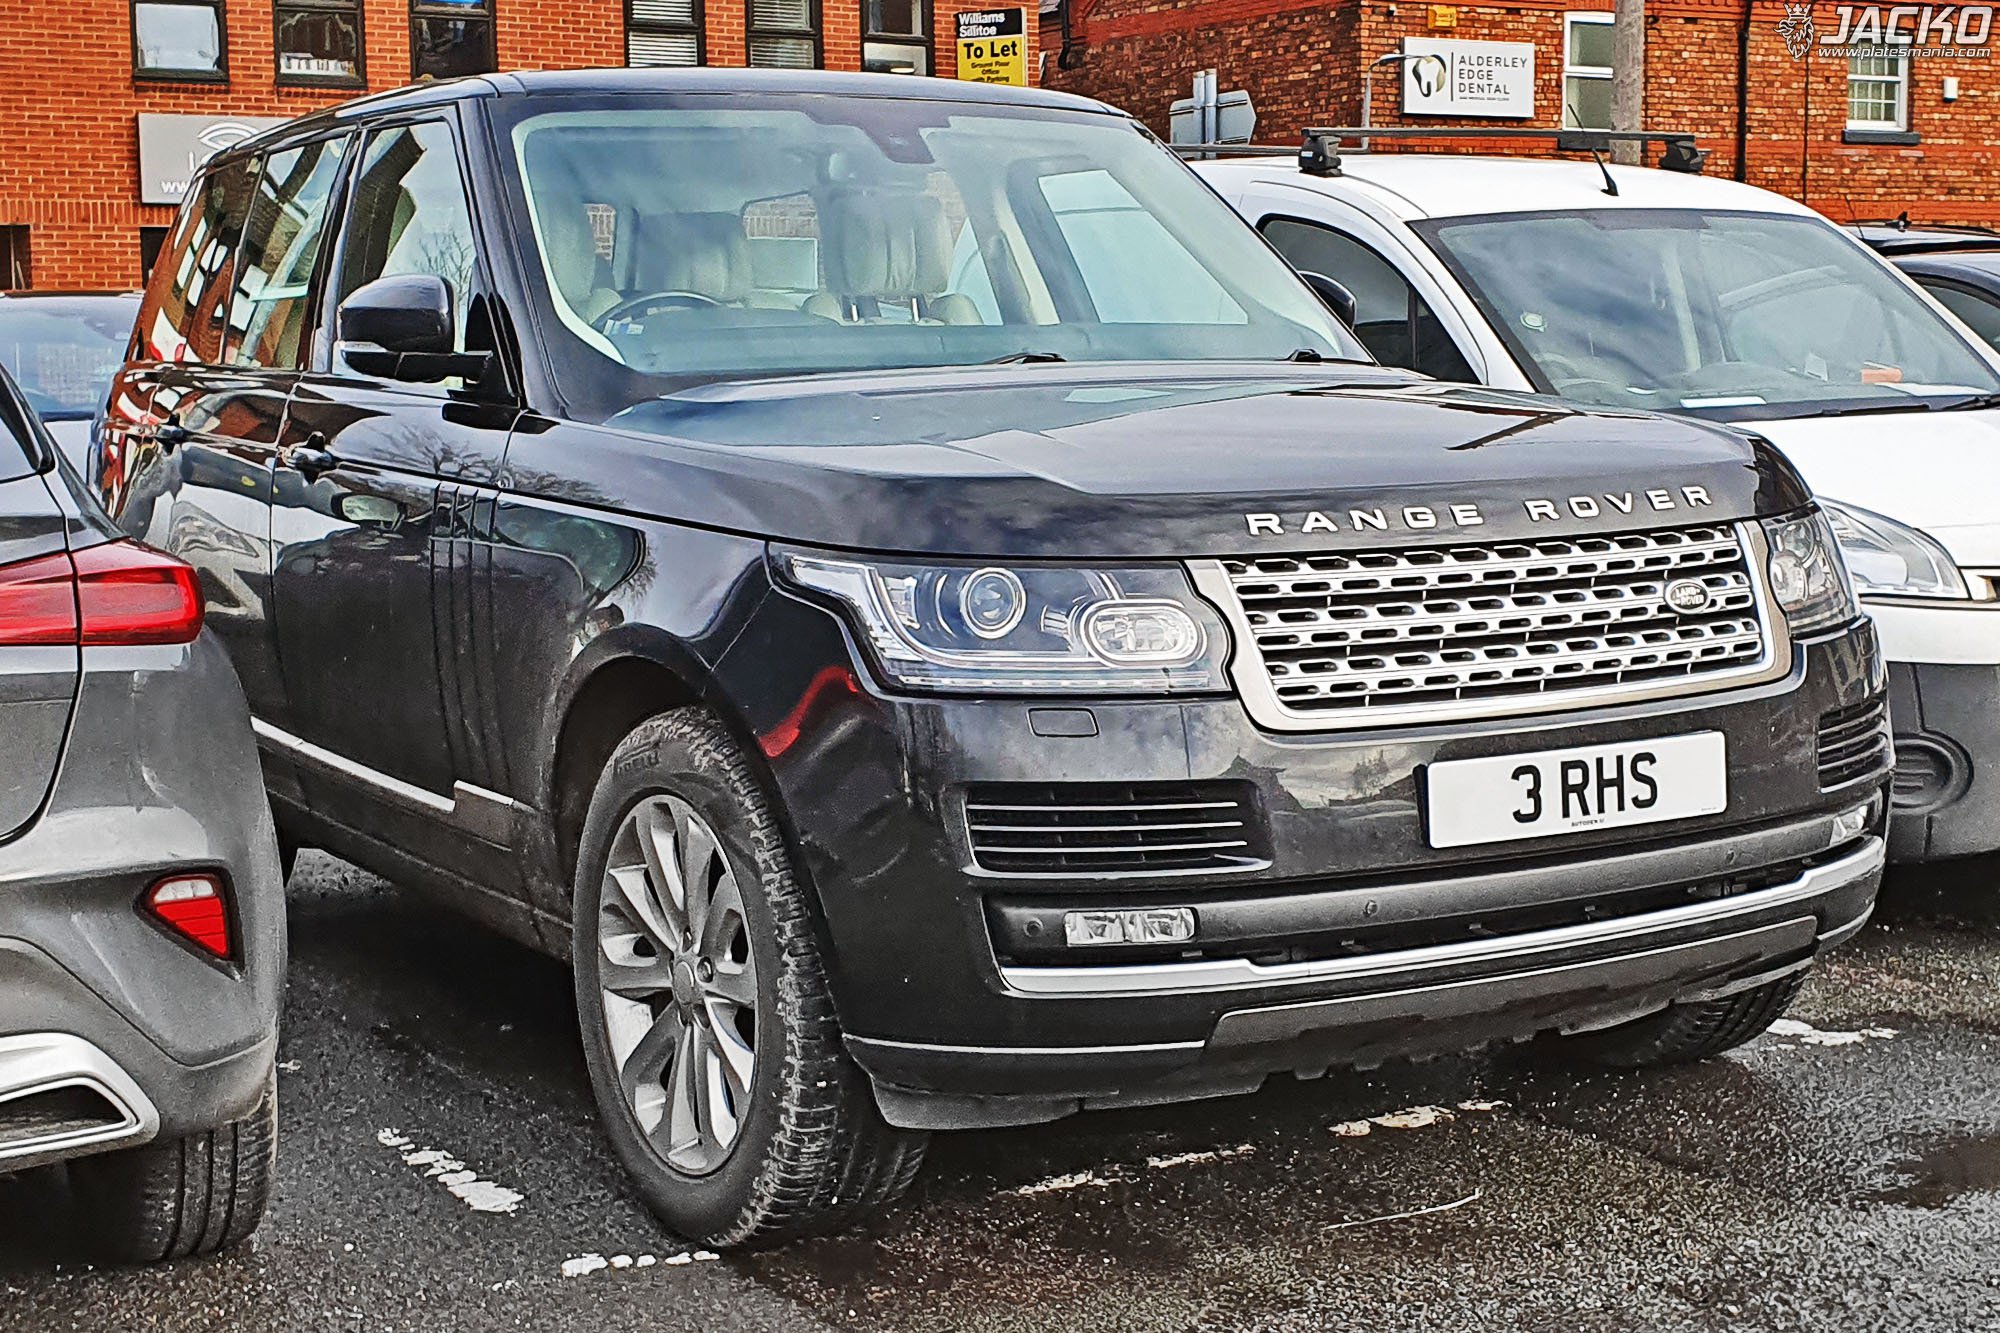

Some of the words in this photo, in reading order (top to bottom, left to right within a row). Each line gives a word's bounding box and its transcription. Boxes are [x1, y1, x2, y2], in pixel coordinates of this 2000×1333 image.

[958, 12, 1005, 25] Williams
[959, 25, 997, 37] Sillitoe
[963, 43, 983, 59] To
[990, 41, 1018, 57] Let
[1458, 55, 1528, 68] ALDERLEY
[1458, 68, 1494, 80] EDGE
[1458, 82, 1511, 95] DENTAL
[1244, 504, 1485, 536] RANGE
[1523, 485, 1713, 522] ROVER
[1510, 764, 1543, 824] 3
[1560, 751, 1658, 819] RHS
